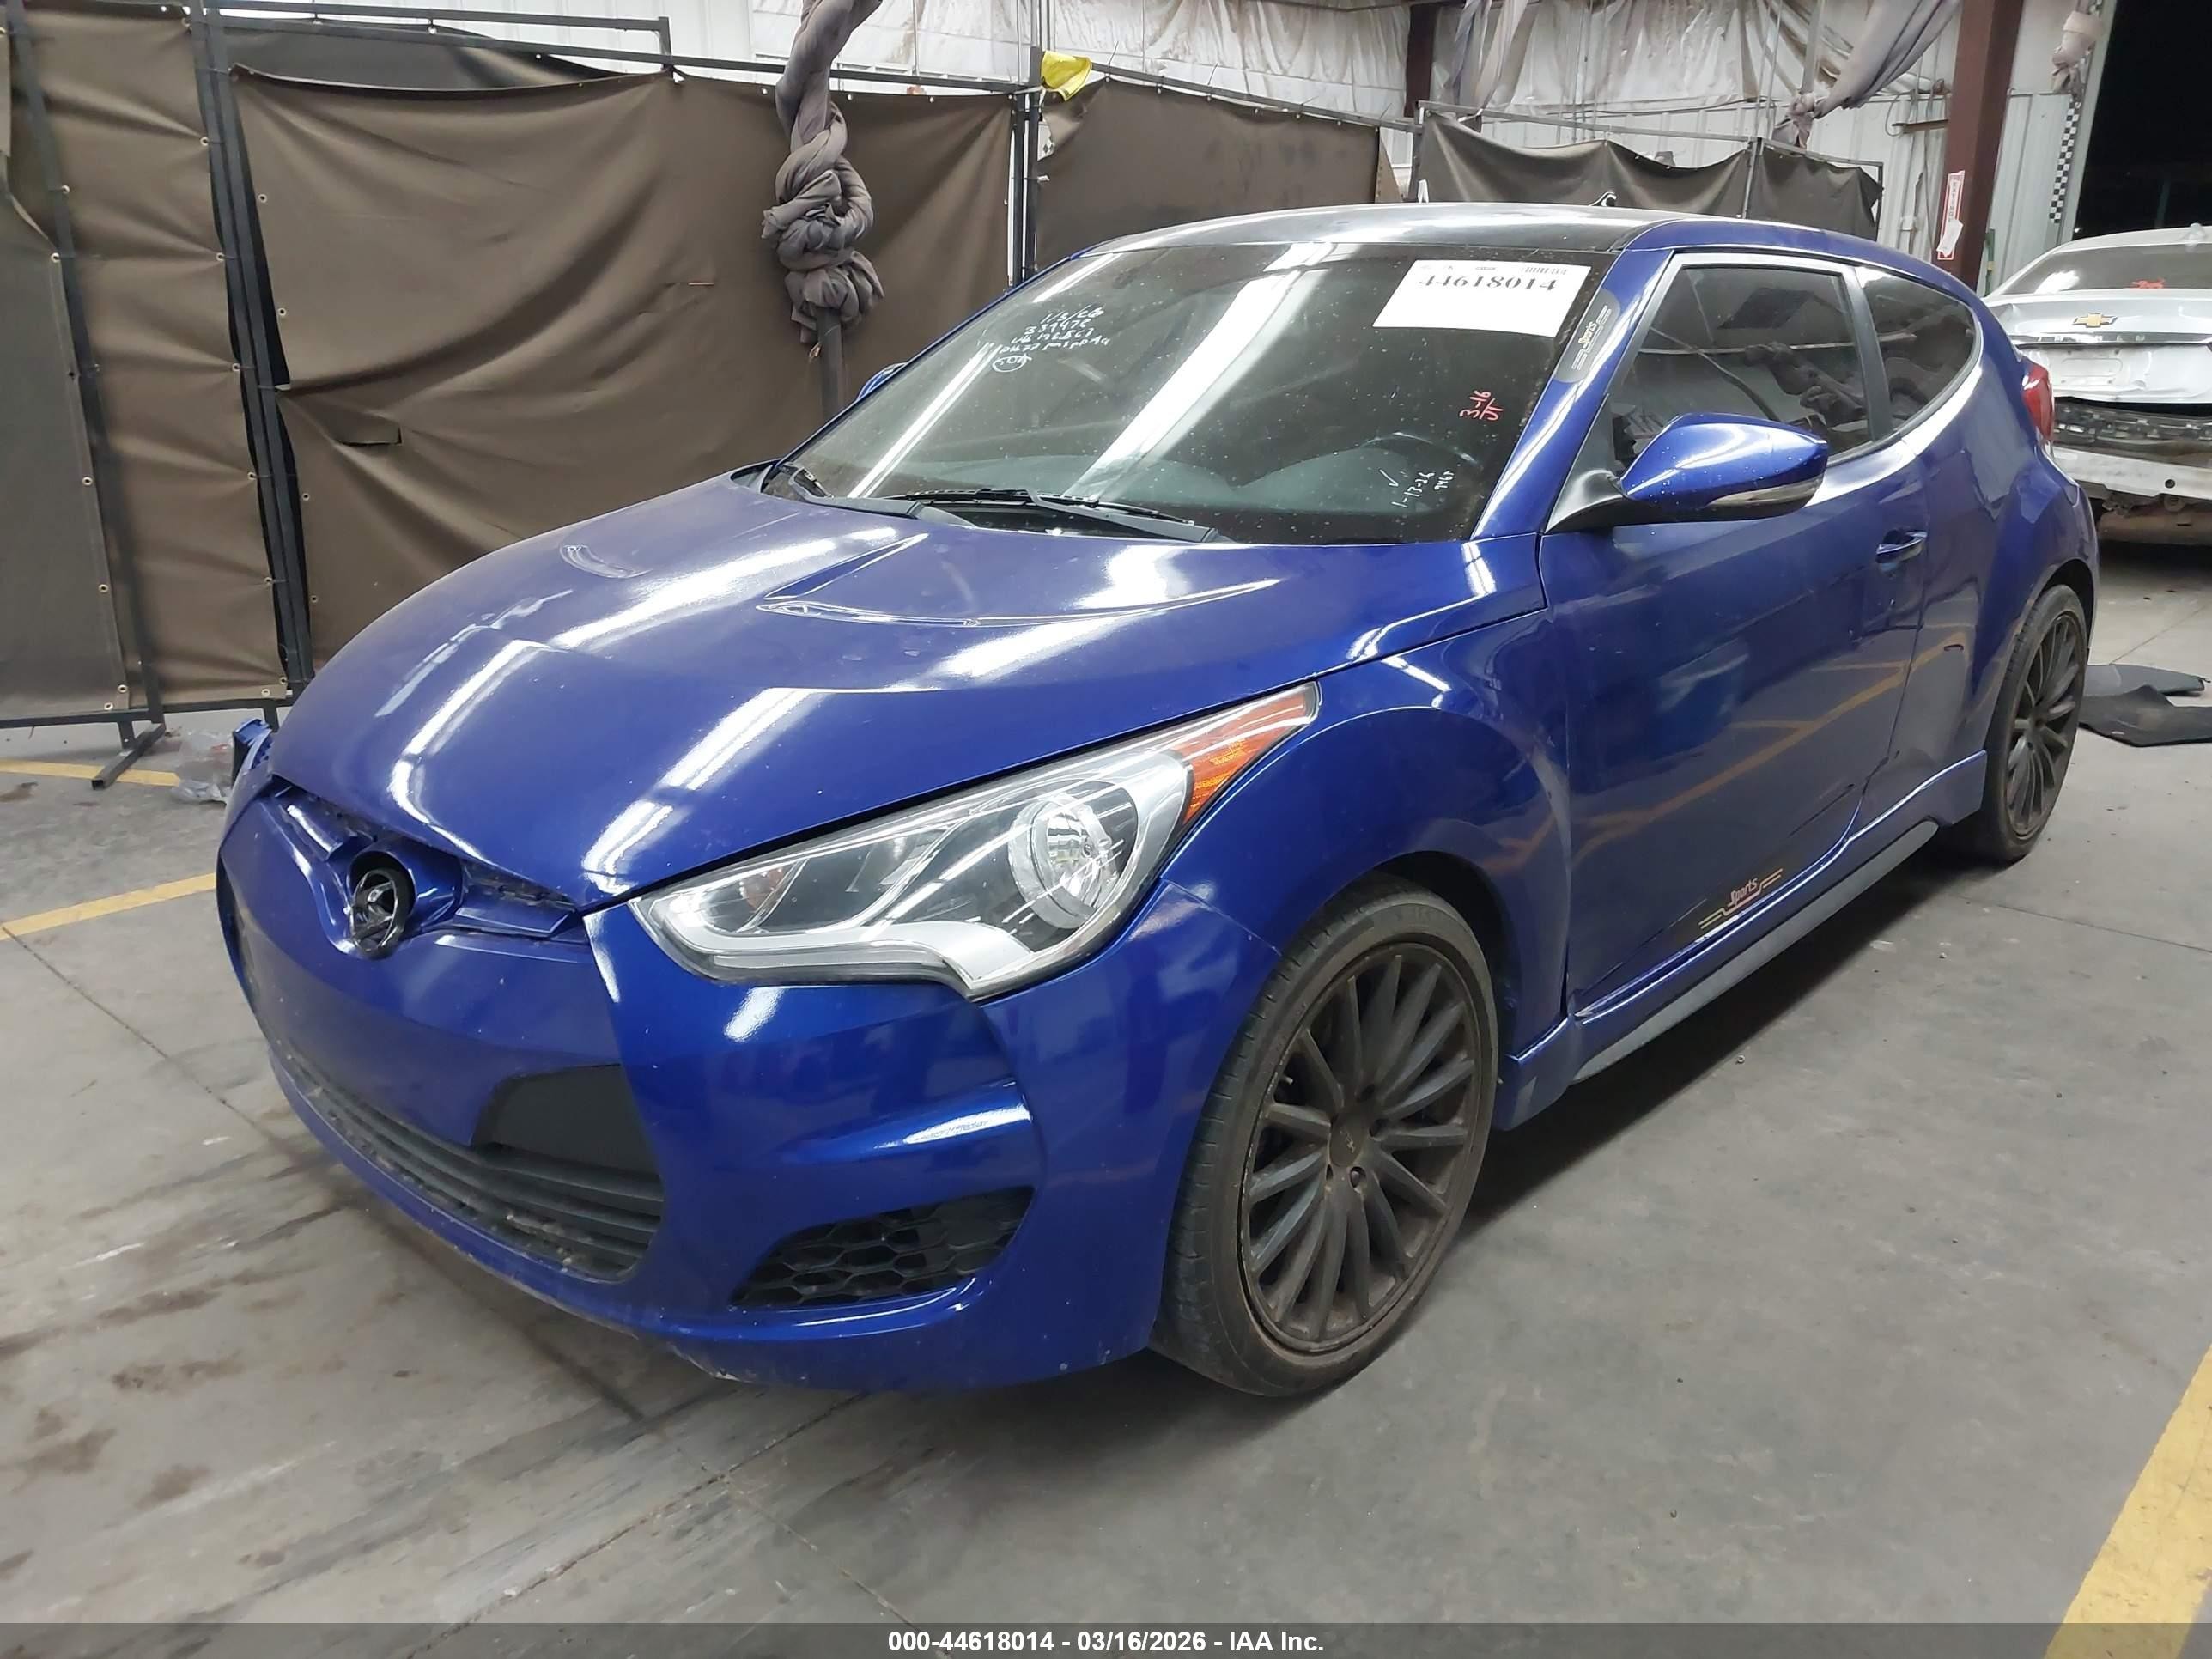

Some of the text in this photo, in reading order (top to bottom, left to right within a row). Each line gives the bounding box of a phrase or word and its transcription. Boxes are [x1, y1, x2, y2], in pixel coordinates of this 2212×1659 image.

[1419, 275, 1557, 291] 44618014
[1459, 390, 1492, 419] 3-16
[1727, 878, 1759, 908] Sports
